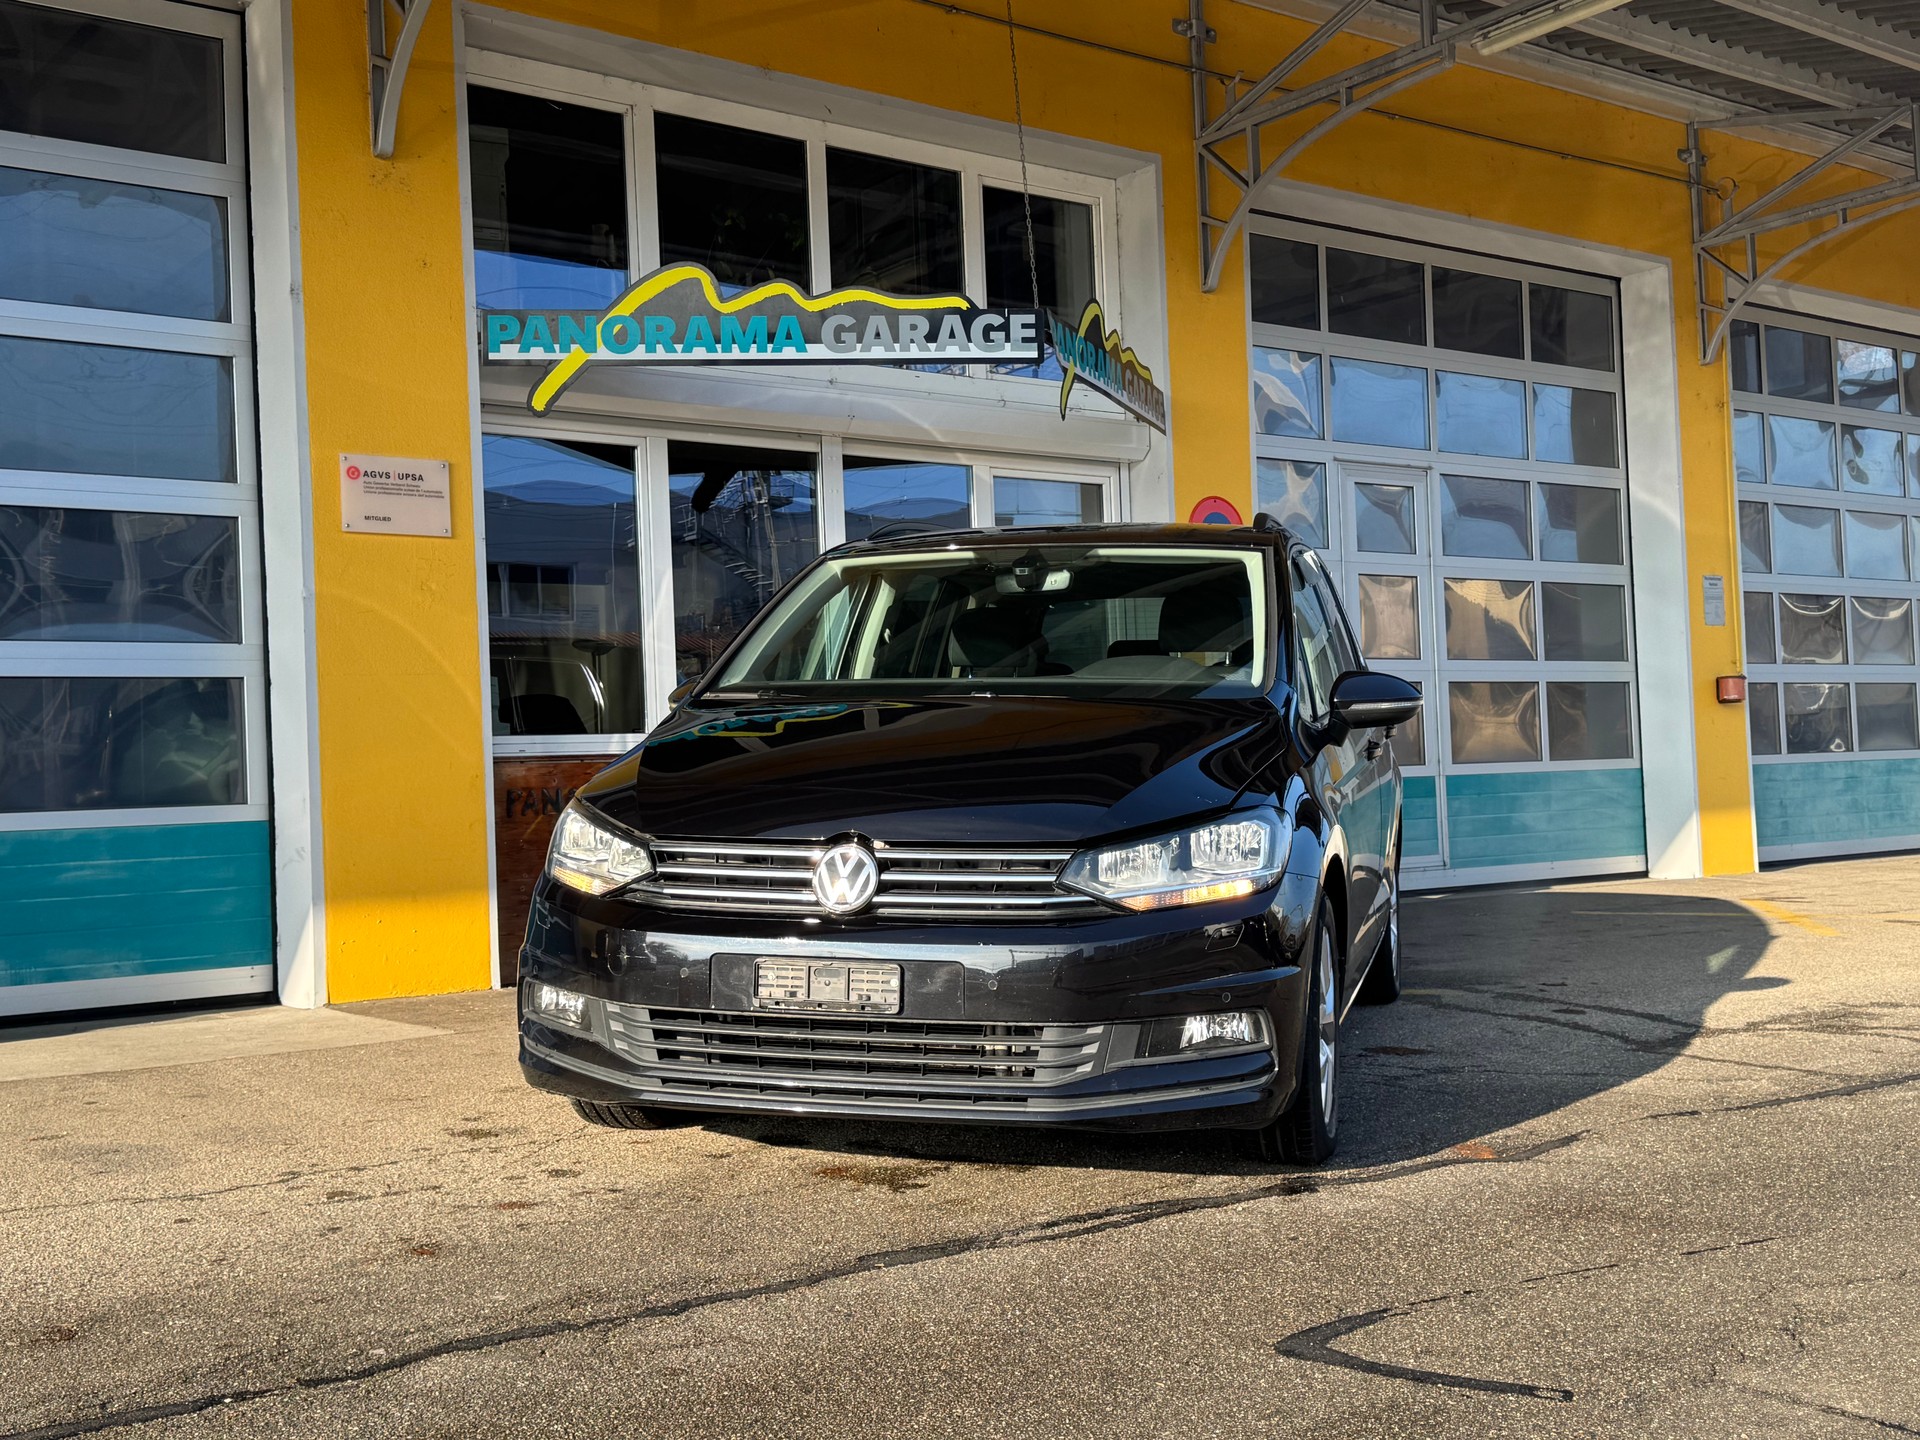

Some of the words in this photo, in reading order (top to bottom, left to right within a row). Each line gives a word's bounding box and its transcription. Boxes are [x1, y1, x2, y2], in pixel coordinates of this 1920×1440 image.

[487, 314, 808, 354] PANORAMA
[821, 314, 1038, 353] GARAGE
[1125, 368, 1166, 424] GARAGE
[363, 470, 391, 479] AGVS
[397, 472, 424, 482] UPSA
[816, 846, 876, 910] VW
